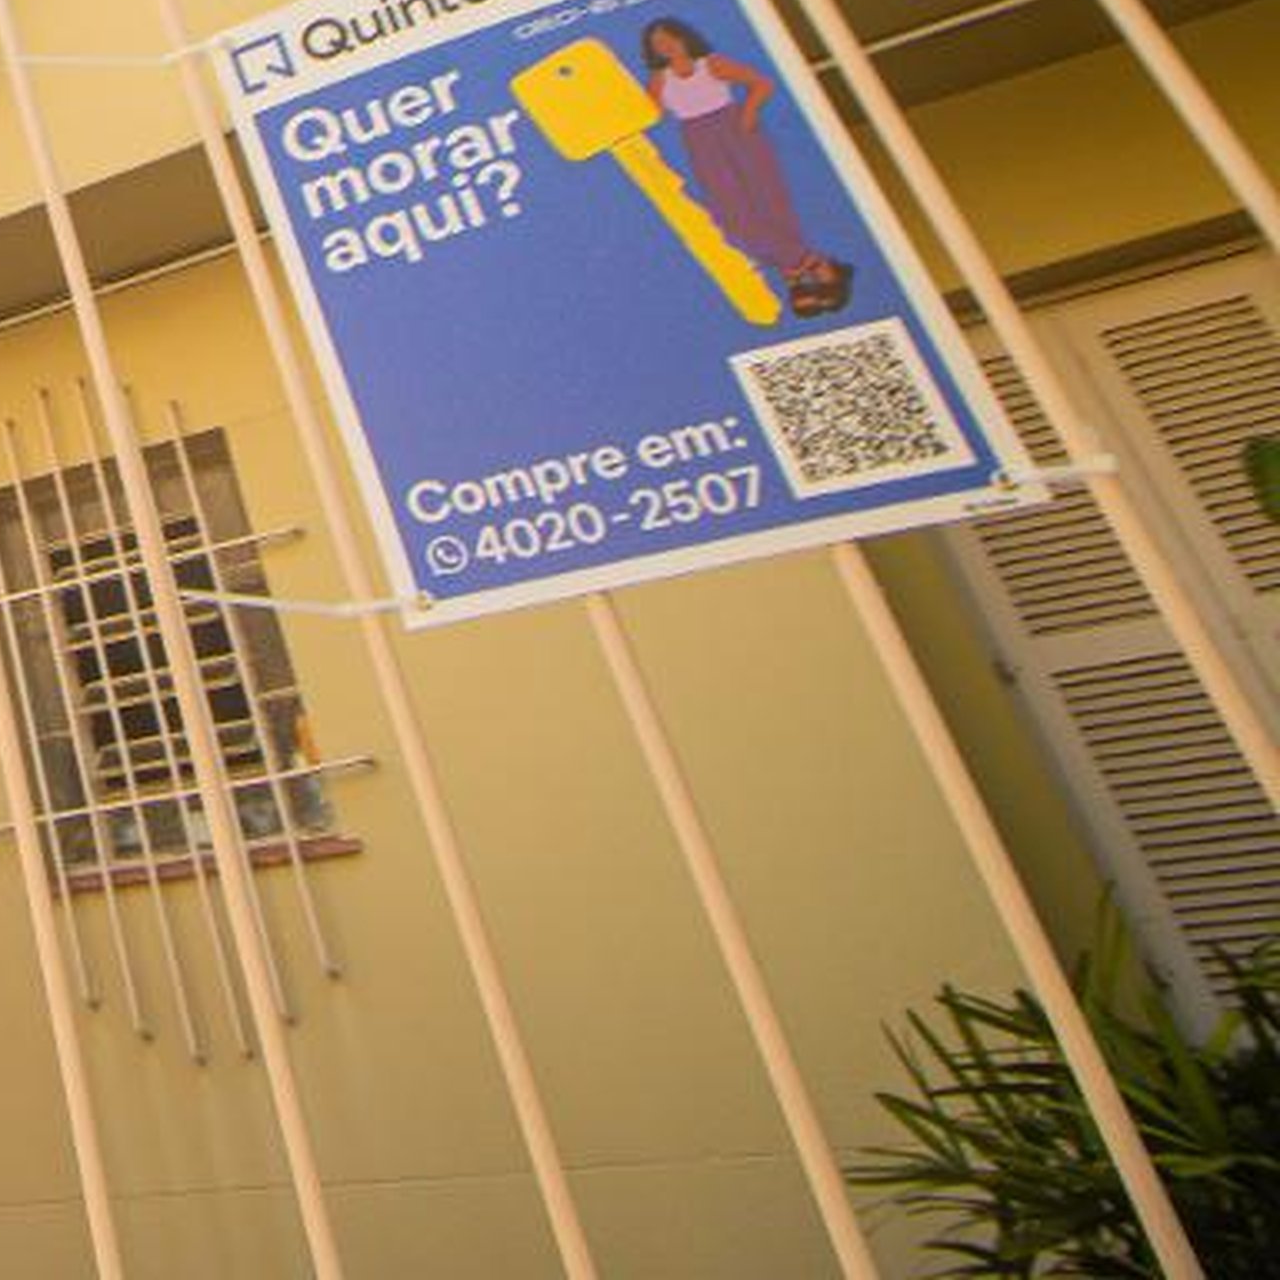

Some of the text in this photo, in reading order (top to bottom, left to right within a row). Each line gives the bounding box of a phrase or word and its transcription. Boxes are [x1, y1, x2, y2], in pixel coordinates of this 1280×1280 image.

[282, 69, 460, 163] Quer
[301, 109, 519, 218] morar
[321, 159, 523, 273] aqui?
[407, 417, 748, 523] Compre em:
[475, 465, 761, 565] 4020-2507
